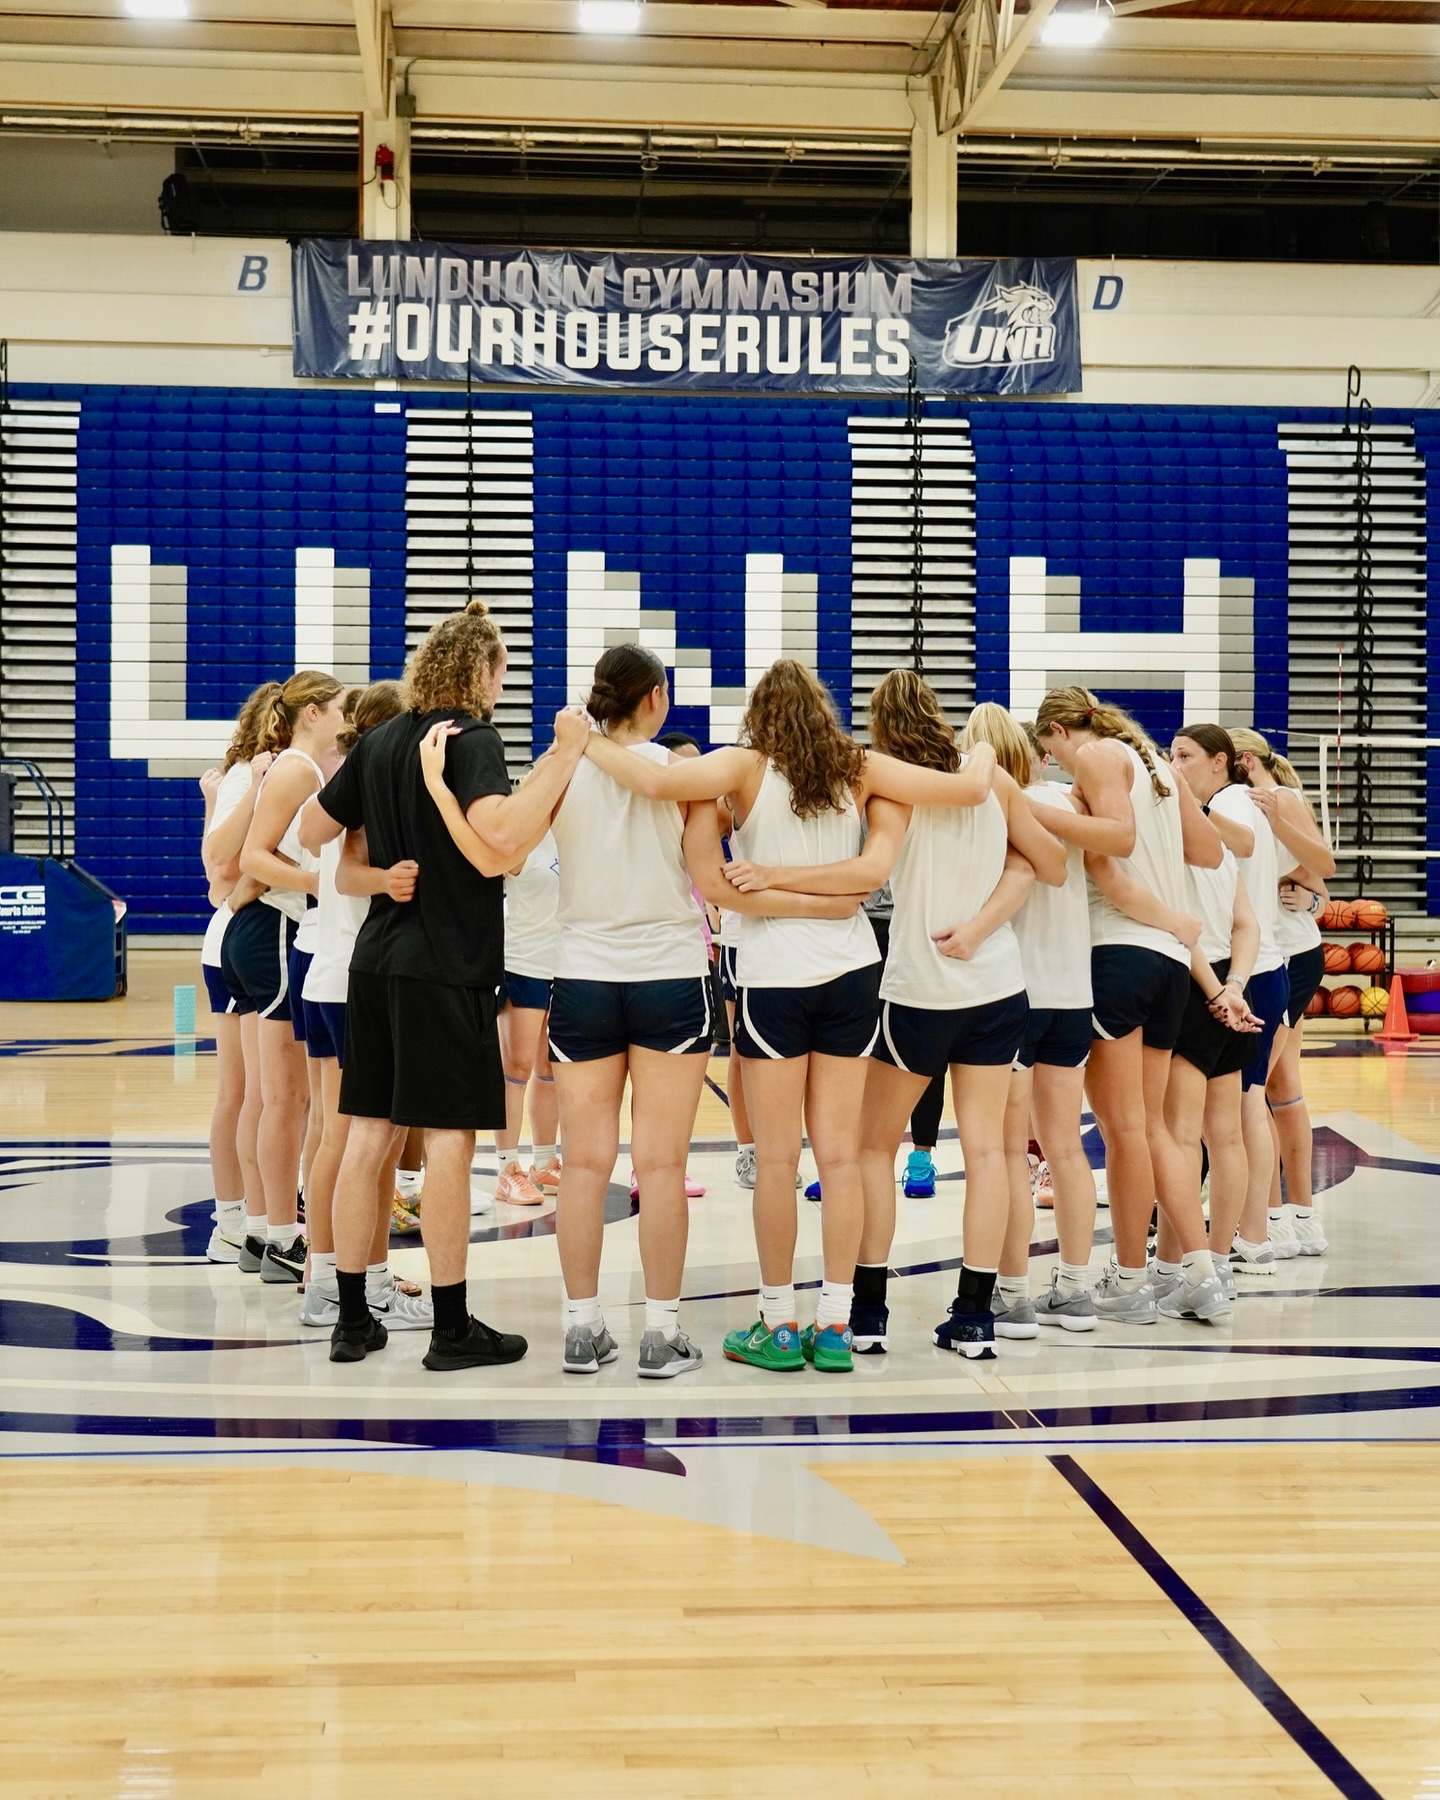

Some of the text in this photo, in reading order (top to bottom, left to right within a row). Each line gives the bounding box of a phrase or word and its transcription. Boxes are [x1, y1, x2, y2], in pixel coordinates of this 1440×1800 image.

[238, 255, 268, 291] B
[347, 255, 912, 313] LUNDHOLM GYMNASIUM
[1092, 275, 1123, 310] D
[347, 301, 911, 377] #OURHOUSERULES
[953, 325, 1053, 363] UNH
